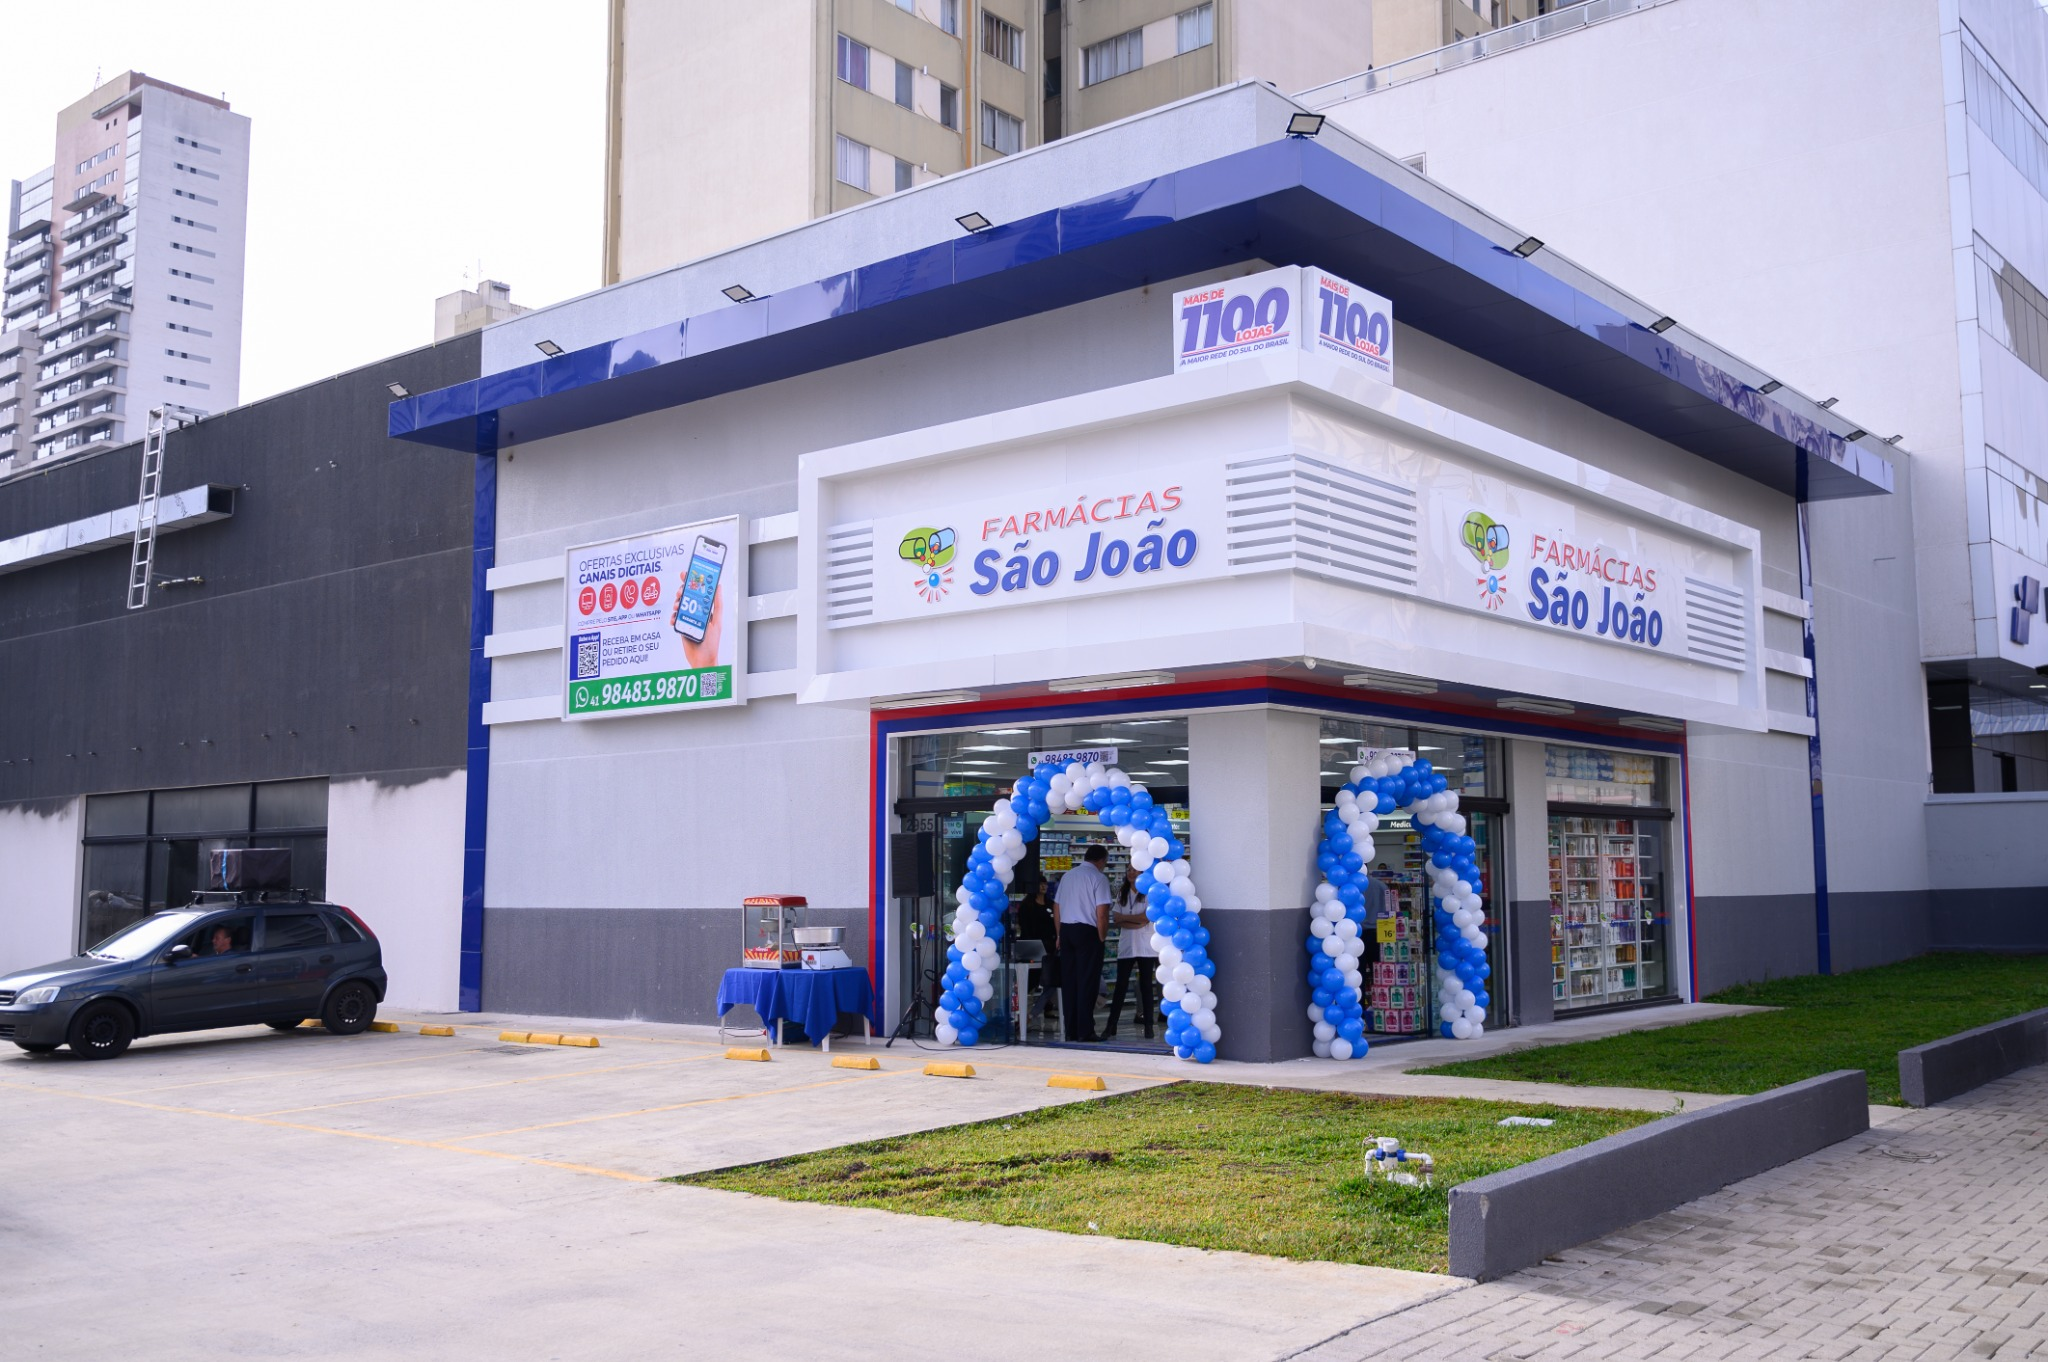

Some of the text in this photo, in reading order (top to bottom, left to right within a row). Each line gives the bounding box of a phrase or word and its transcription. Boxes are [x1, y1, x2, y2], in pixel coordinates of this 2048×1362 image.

[1183, 288, 1225, 306] MAIS DE
[1320, 276, 1349, 297] MAIS DE
[1181, 286, 1290, 354] 1100
[1319, 286, 1390, 357] 1100
[1235, 325, 1273, 343] LOJAS
[1180, 337, 1289, 366] A MAIOR REDE DO SUL DO BRASIL
[1323, 341, 1339, 352] MAIOR
[1339, 347, 1351, 358] REDE
[1351, 352, 1358, 360] DO
[1358, 355, 1366, 364] SUL
[1355, 338, 1379, 357] LOJAS
[982, 486, 1183, 541] FARMÁCIAS
[580, 555, 622, 572] OFERTAS
[625, 543, 685, 565] EXCLUSIVAS
[969, 517, 1198, 597] São João
[1531, 534, 1657, 593] FARMÁCIAS
[579, 561, 663, 585] CANAIS DIGITAIS.
[636, 610, 662, 619] WHATSAPP
[1527, 566, 1663, 648] São João
[602, 631, 661, 647] RECEBA EM CASA
[602, 642, 660, 657] OU RETIRE O SEU
[602, 656, 629, 667] PEDIDO
[590, 695, 600, 706] 41
[602, 674, 697, 706] 98483.9870
[1384, 930, 1393, 938] 16
